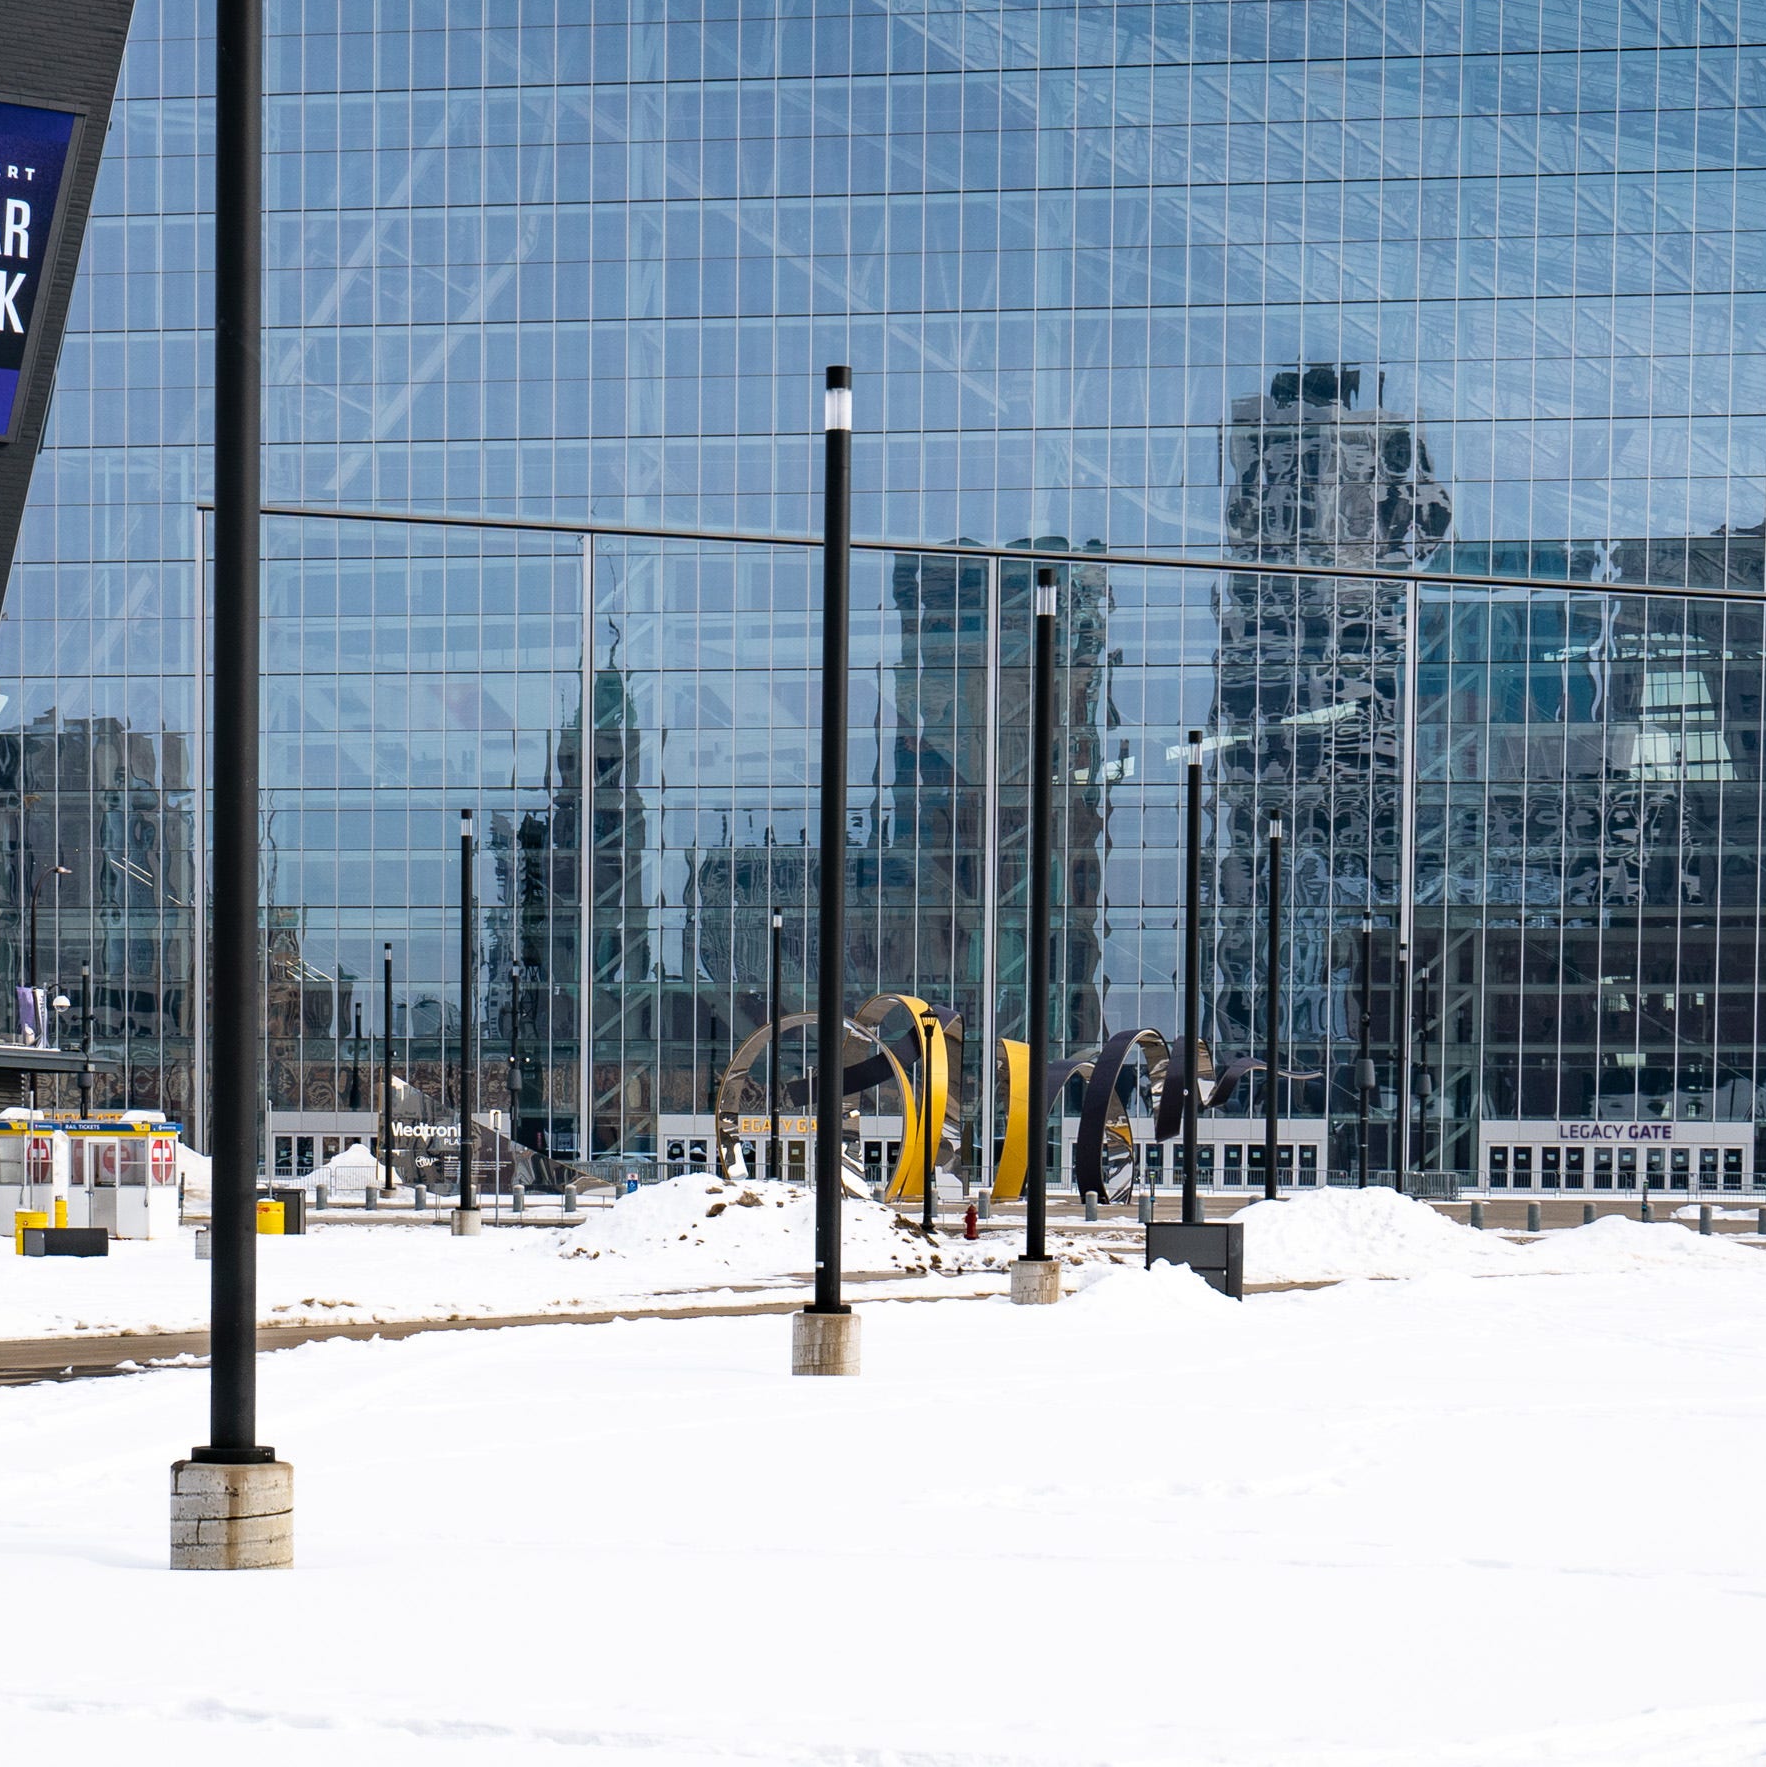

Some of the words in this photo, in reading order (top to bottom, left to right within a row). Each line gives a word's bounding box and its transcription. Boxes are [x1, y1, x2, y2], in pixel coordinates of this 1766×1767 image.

[391, 1121, 462, 1138] Medtroni
[741, 1118, 793, 1133] EGAY
[1560, 1124, 1623, 1139] LEGACY
[1628, 1125, 1672, 1139] GATE
[443, 1138, 461, 1146] PLA
